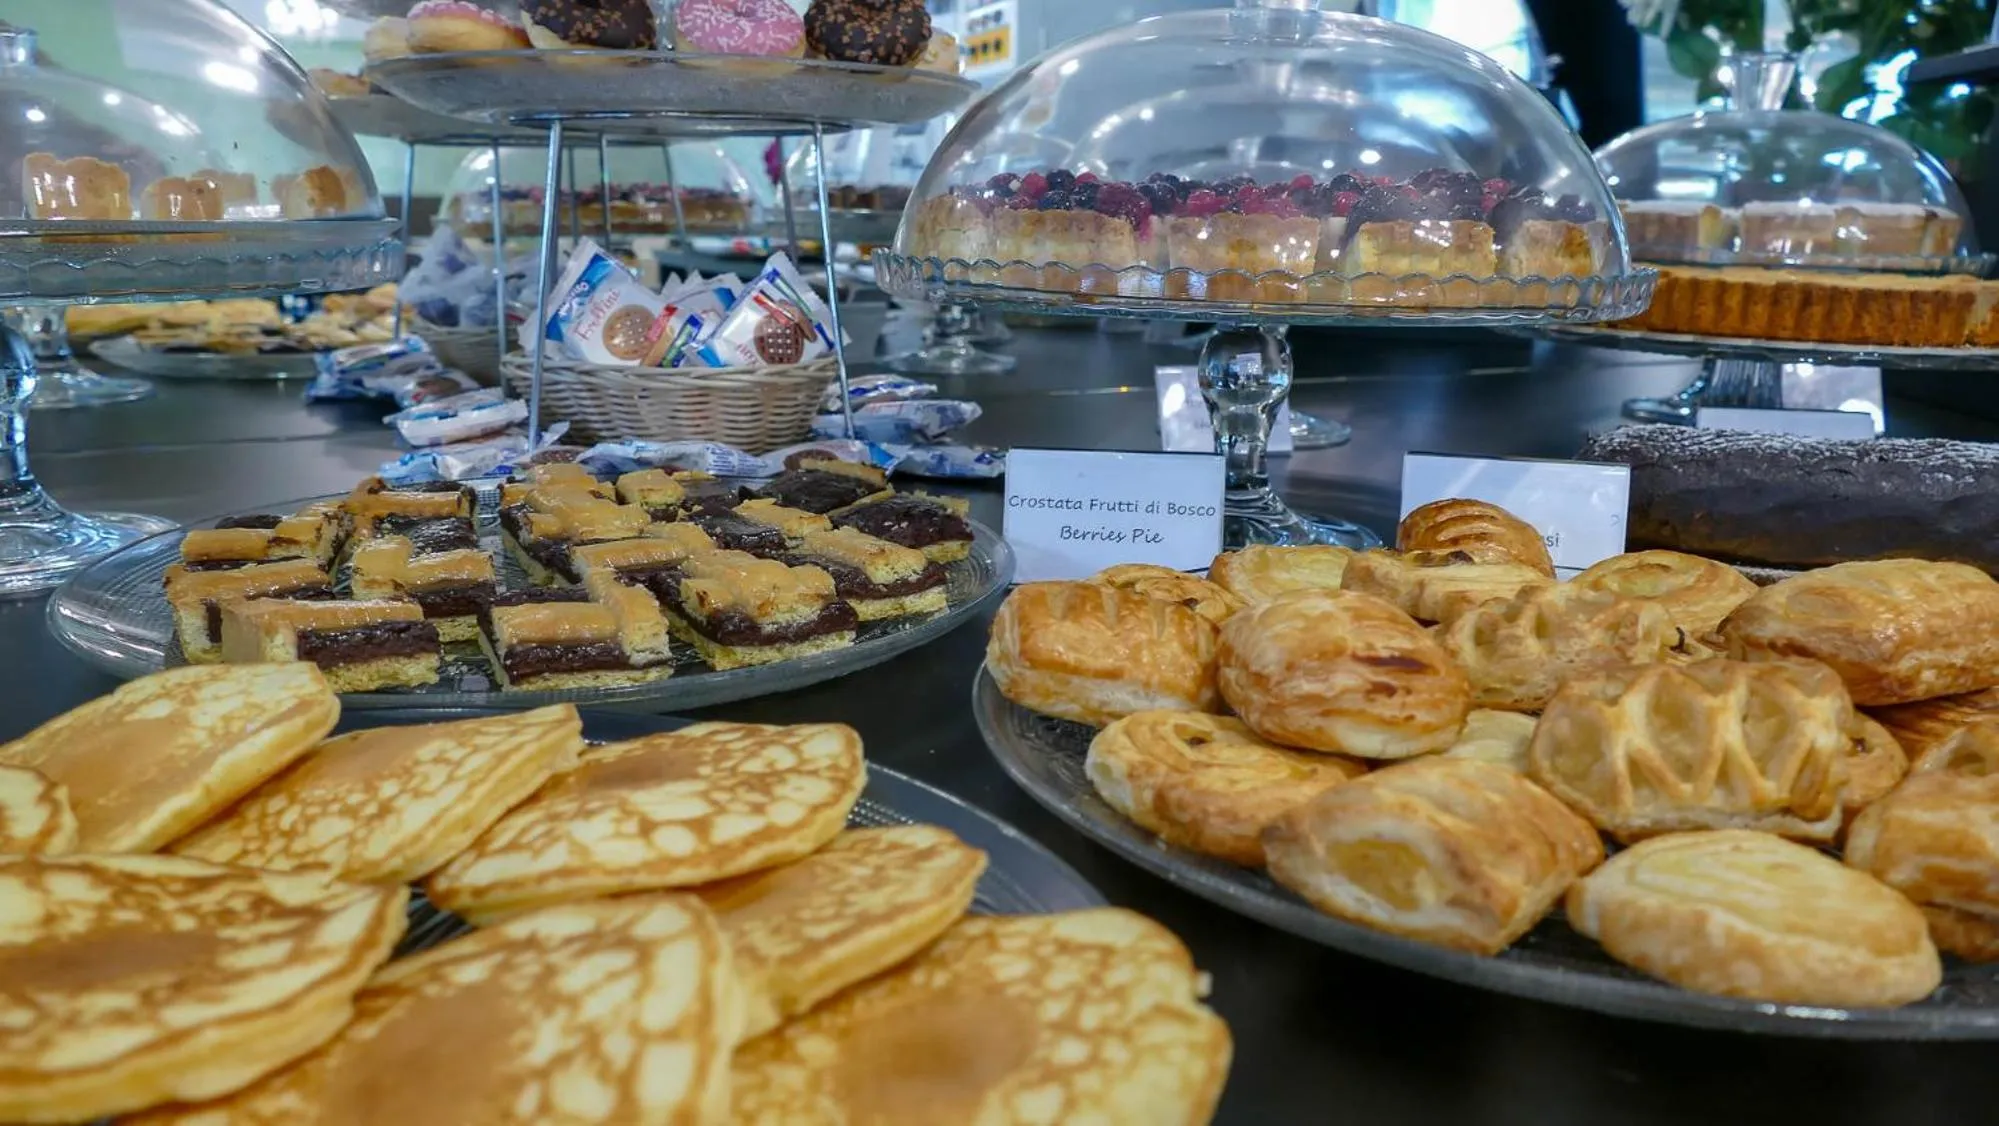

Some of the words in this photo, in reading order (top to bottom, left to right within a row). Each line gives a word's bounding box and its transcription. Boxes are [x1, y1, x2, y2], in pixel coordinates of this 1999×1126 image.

[1008, 495, 1083, 510] Crostata
[1089, 498, 1139, 514] Frutti
[1145, 500, 1160, 514] di
[1167, 502, 1216, 517] Bosco
[1059, 525, 1126, 544] Berries
[1132, 528, 1165, 544] Pie
